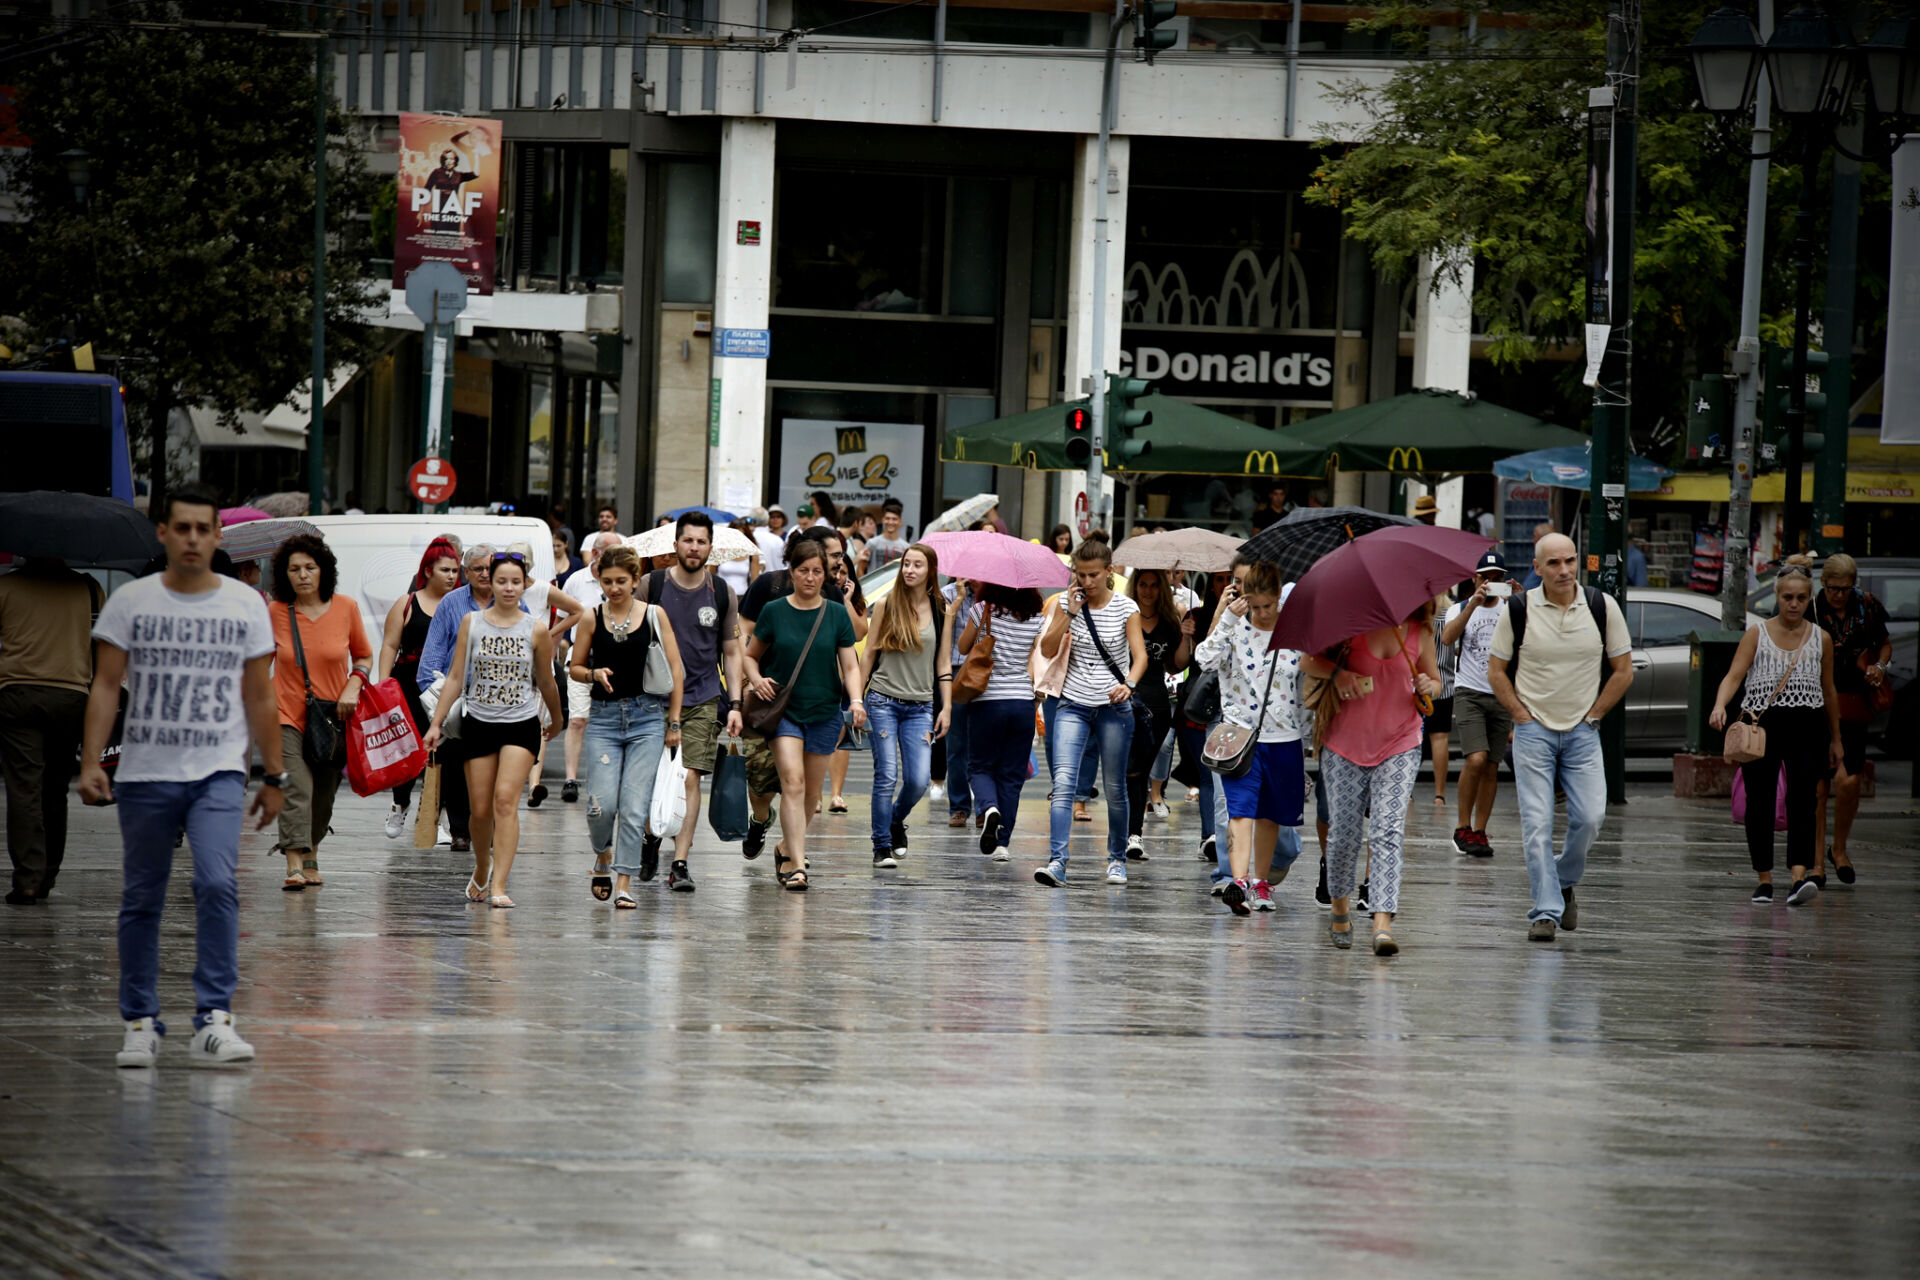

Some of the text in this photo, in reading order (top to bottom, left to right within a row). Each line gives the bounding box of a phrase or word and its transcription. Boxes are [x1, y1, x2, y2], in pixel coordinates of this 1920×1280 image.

[411, 187, 483, 216] PIAF
[423, 213, 469, 223] THE SHOW
[1119, 347, 1332, 387] cDonald's
[132, 614, 248, 645] FUNCTION
[479, 636, 525, 657] MORE
